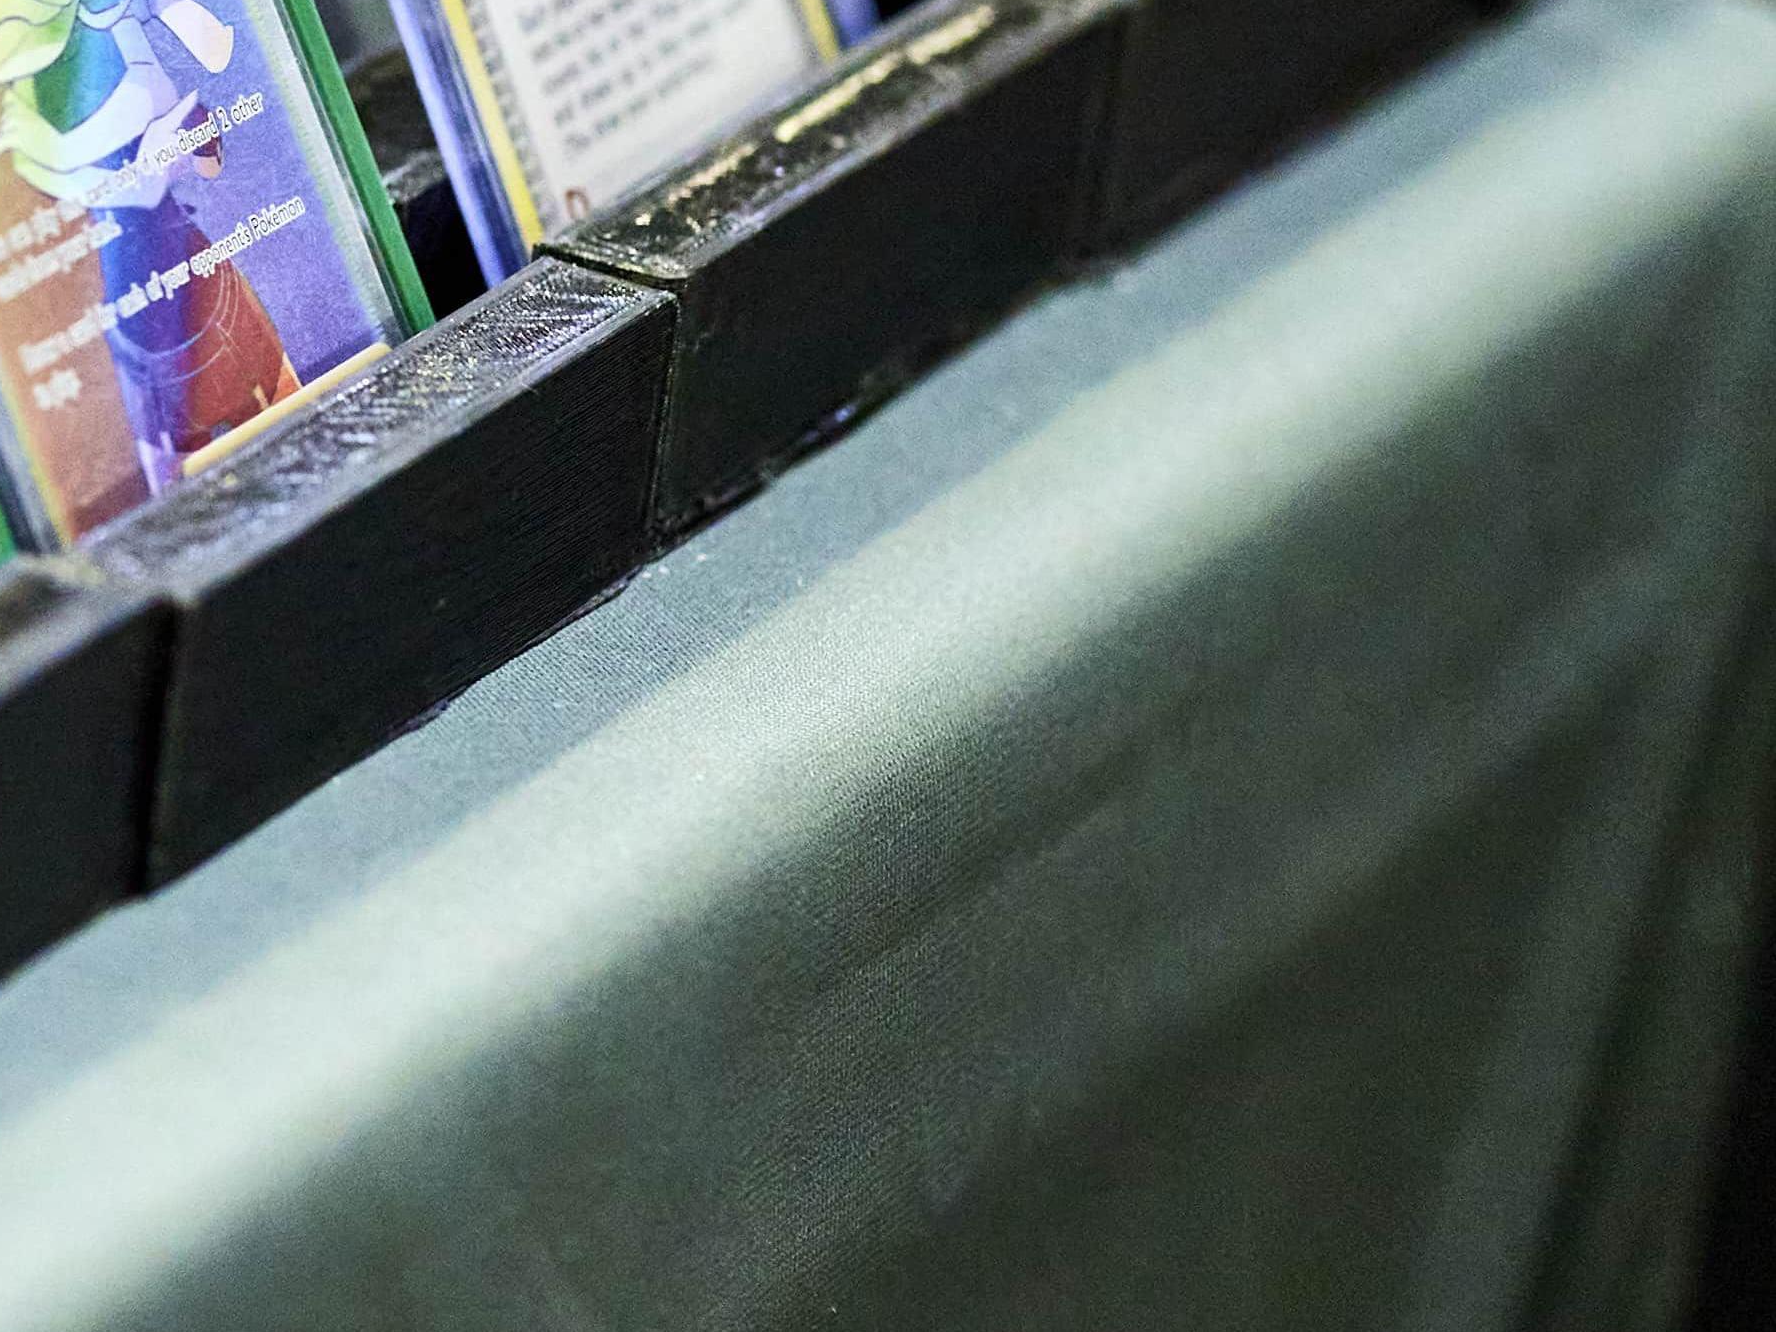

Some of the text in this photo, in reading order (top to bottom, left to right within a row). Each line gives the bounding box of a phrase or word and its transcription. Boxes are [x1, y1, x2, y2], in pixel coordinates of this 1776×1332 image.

[177, 119, 220, 155] discard
[218, 110, 230, 131] 2
[231, 93, 264, 126] other
[191, 225, 252, 277] opponent's
[250, 196, 306, 240] Pokémon
